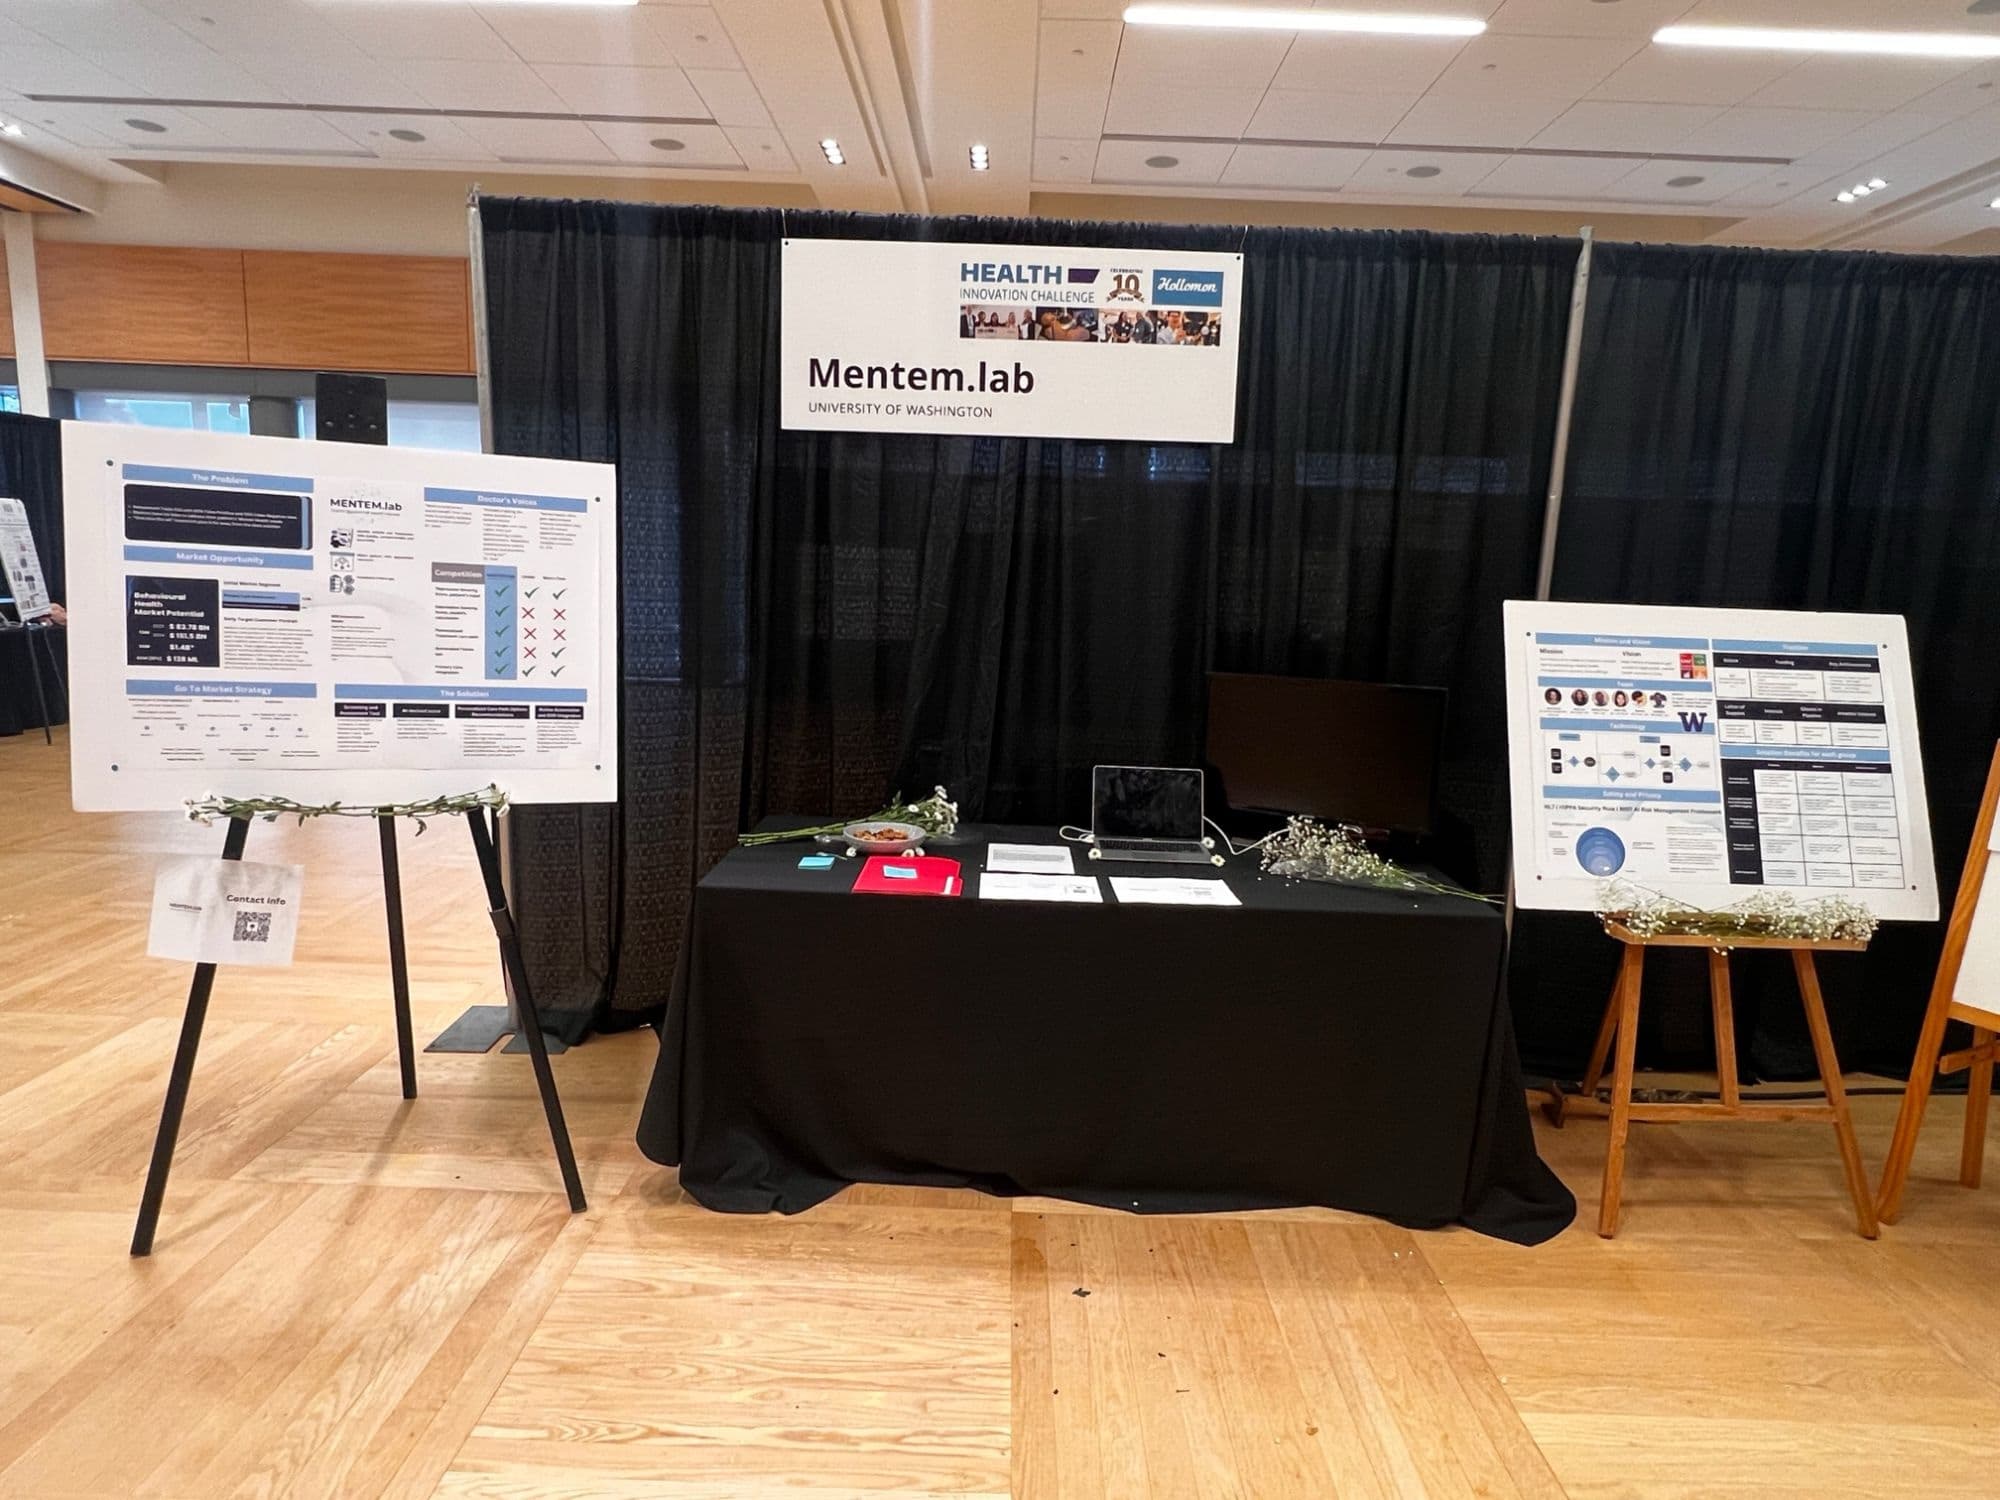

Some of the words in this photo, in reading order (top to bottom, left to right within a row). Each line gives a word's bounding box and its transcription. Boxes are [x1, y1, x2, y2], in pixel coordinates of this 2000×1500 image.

[961, 263, 1062, 284] HEALTH
[1113, 274, 1140, 293] 10
[1157, 277, 1218, 293] Hollomon
[960, 288, 1028, 301] INNOVATION
[1031, 290, 1095, 303] CHALLENGE
[809, 358, 1035, 393] Mentem.lab
[808, 403, 881, 415] UNIVERSITY
[885, 404, 902, 415] OF
[906, 405, 993, 418] WASHINGTON
[192, 473, 209, 482] The
[210, 475, 249, 485] Problem
[330, 499, 402, 511] MENTEM.lab
[176, 552, 207, 561] Market
[209, 554, 264, 566] Opportunity
[434, 569, 483, 579] Competition
[134, 592, 187, 600] Behavioural
[166, 610, 205, 618] Potential
[202, 686, 233, 694] Market
[235, 686, 272, 696] Strategy
[457, 690, 490, 698] Solution
[1677, 711, 1707, 733] W
[226, 894, 266, 904] Contact
